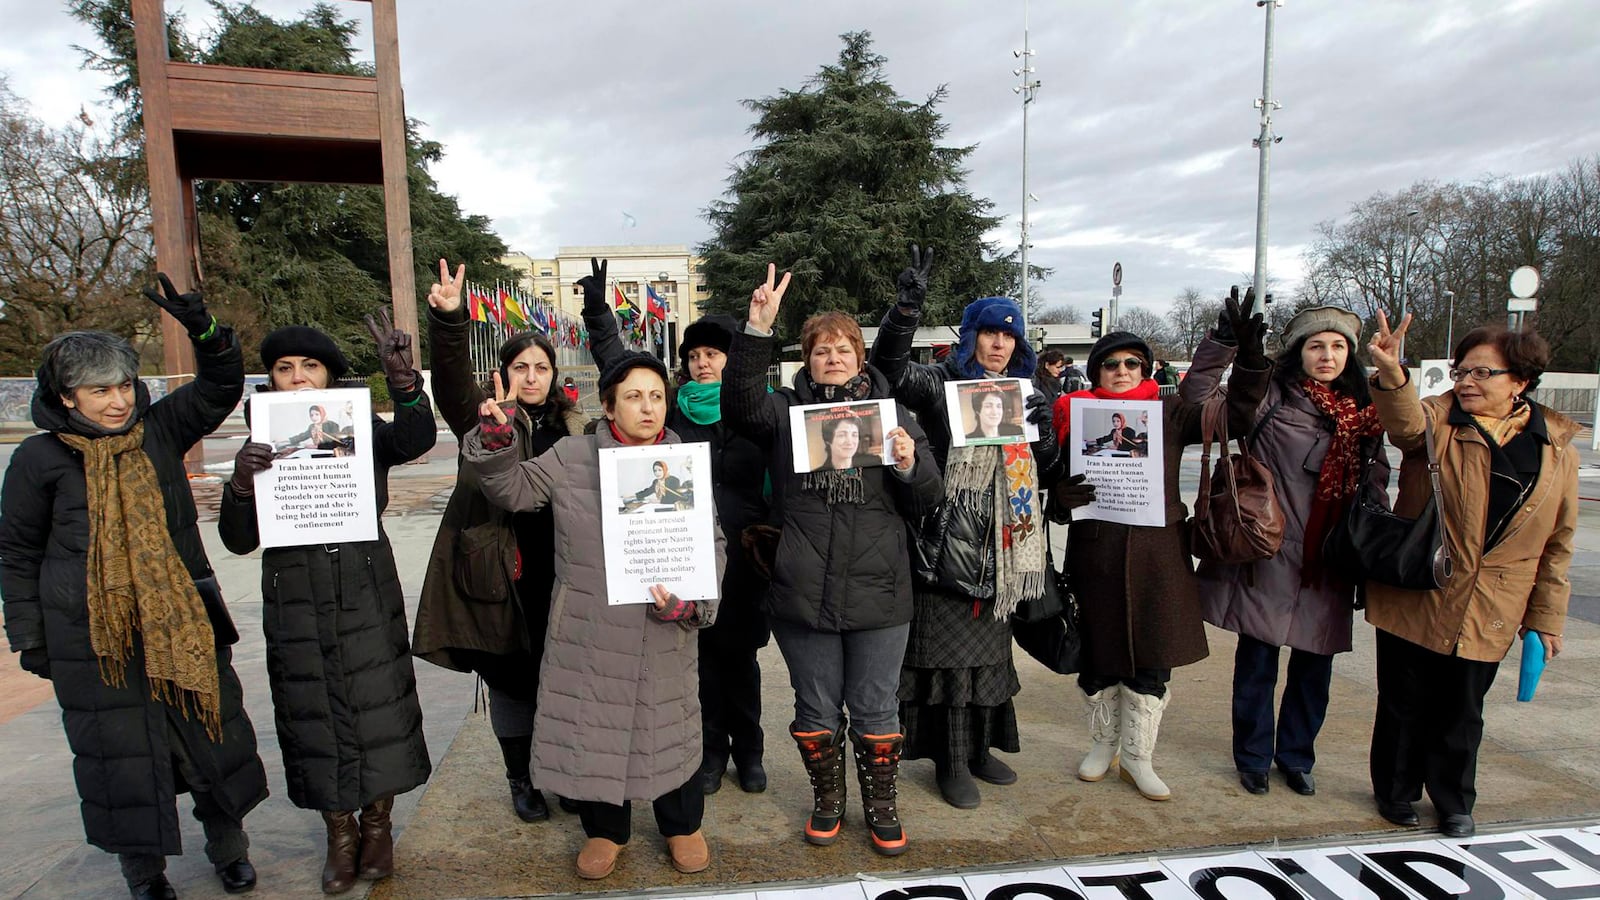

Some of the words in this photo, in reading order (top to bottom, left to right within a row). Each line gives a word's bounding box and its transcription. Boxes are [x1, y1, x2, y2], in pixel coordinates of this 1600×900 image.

[278, 472, 321, 482] prominent
[274, 483, 298, 492] rights
[300, 483, 327, 491] lawyer
[326, 491, 357, 499] security
[628, 527, 662, 536] prominent
[624, 538, 643, 547] rights
[640, 575, 681, 584] confinement
